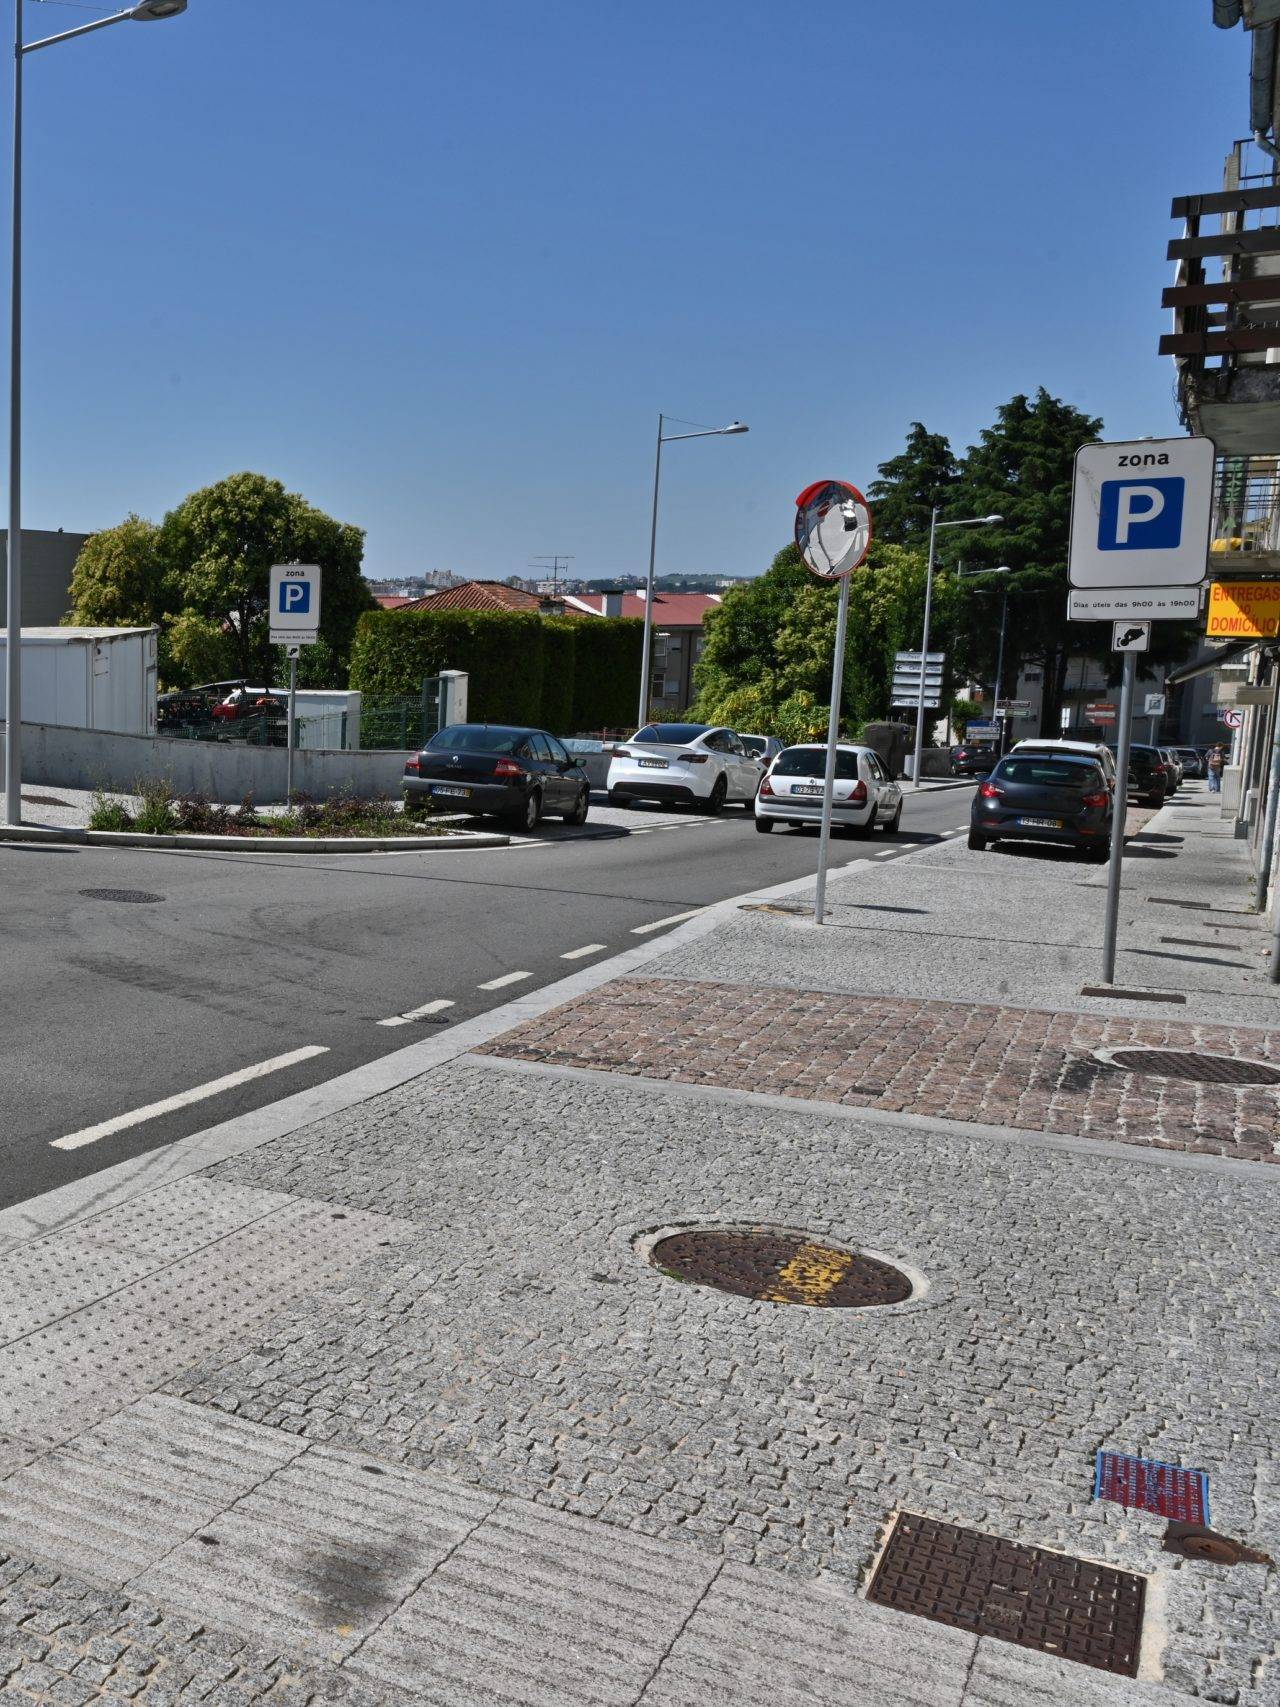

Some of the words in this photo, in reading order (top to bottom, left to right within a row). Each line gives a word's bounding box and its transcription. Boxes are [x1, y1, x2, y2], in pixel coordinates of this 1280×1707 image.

[1118, 452, 1169, 467] zona
[1115, 485, 1165, 544] P
[285, 584, 304, 611] P
[1213, 586, 1280, 601] ENTREGAS
